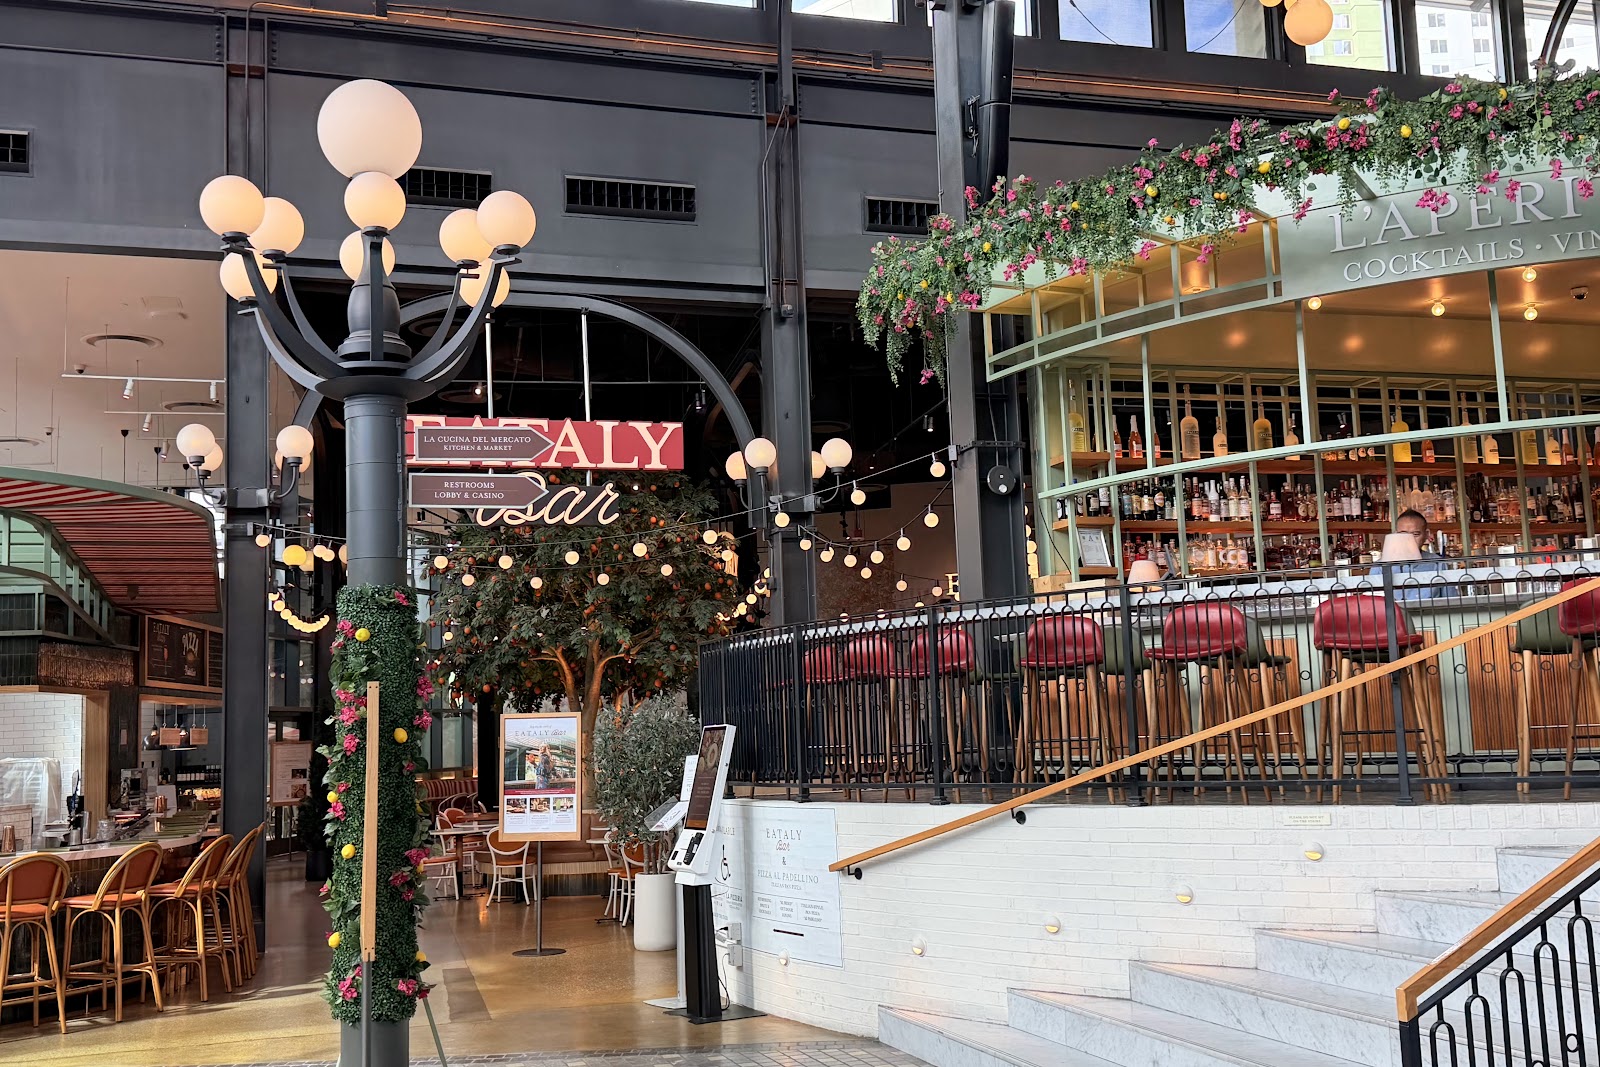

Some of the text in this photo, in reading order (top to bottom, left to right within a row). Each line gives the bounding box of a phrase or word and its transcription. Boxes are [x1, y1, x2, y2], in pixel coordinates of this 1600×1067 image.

[1328, 174, 1600, 253] L'APERI
[1343, 238, 1524, 282] COCKTAILS
[424, 435, 436, 443] LA
[437, 435, 471, 443] CUCINA
[444, 481, 495, 489] RESTROOMS
[434, 491, 462, 499] LOBBY
[766, 828, 802, 840] EATALY
[782, 856, 786, 866] &
[782, 872, 819, 884] PADELLINO
